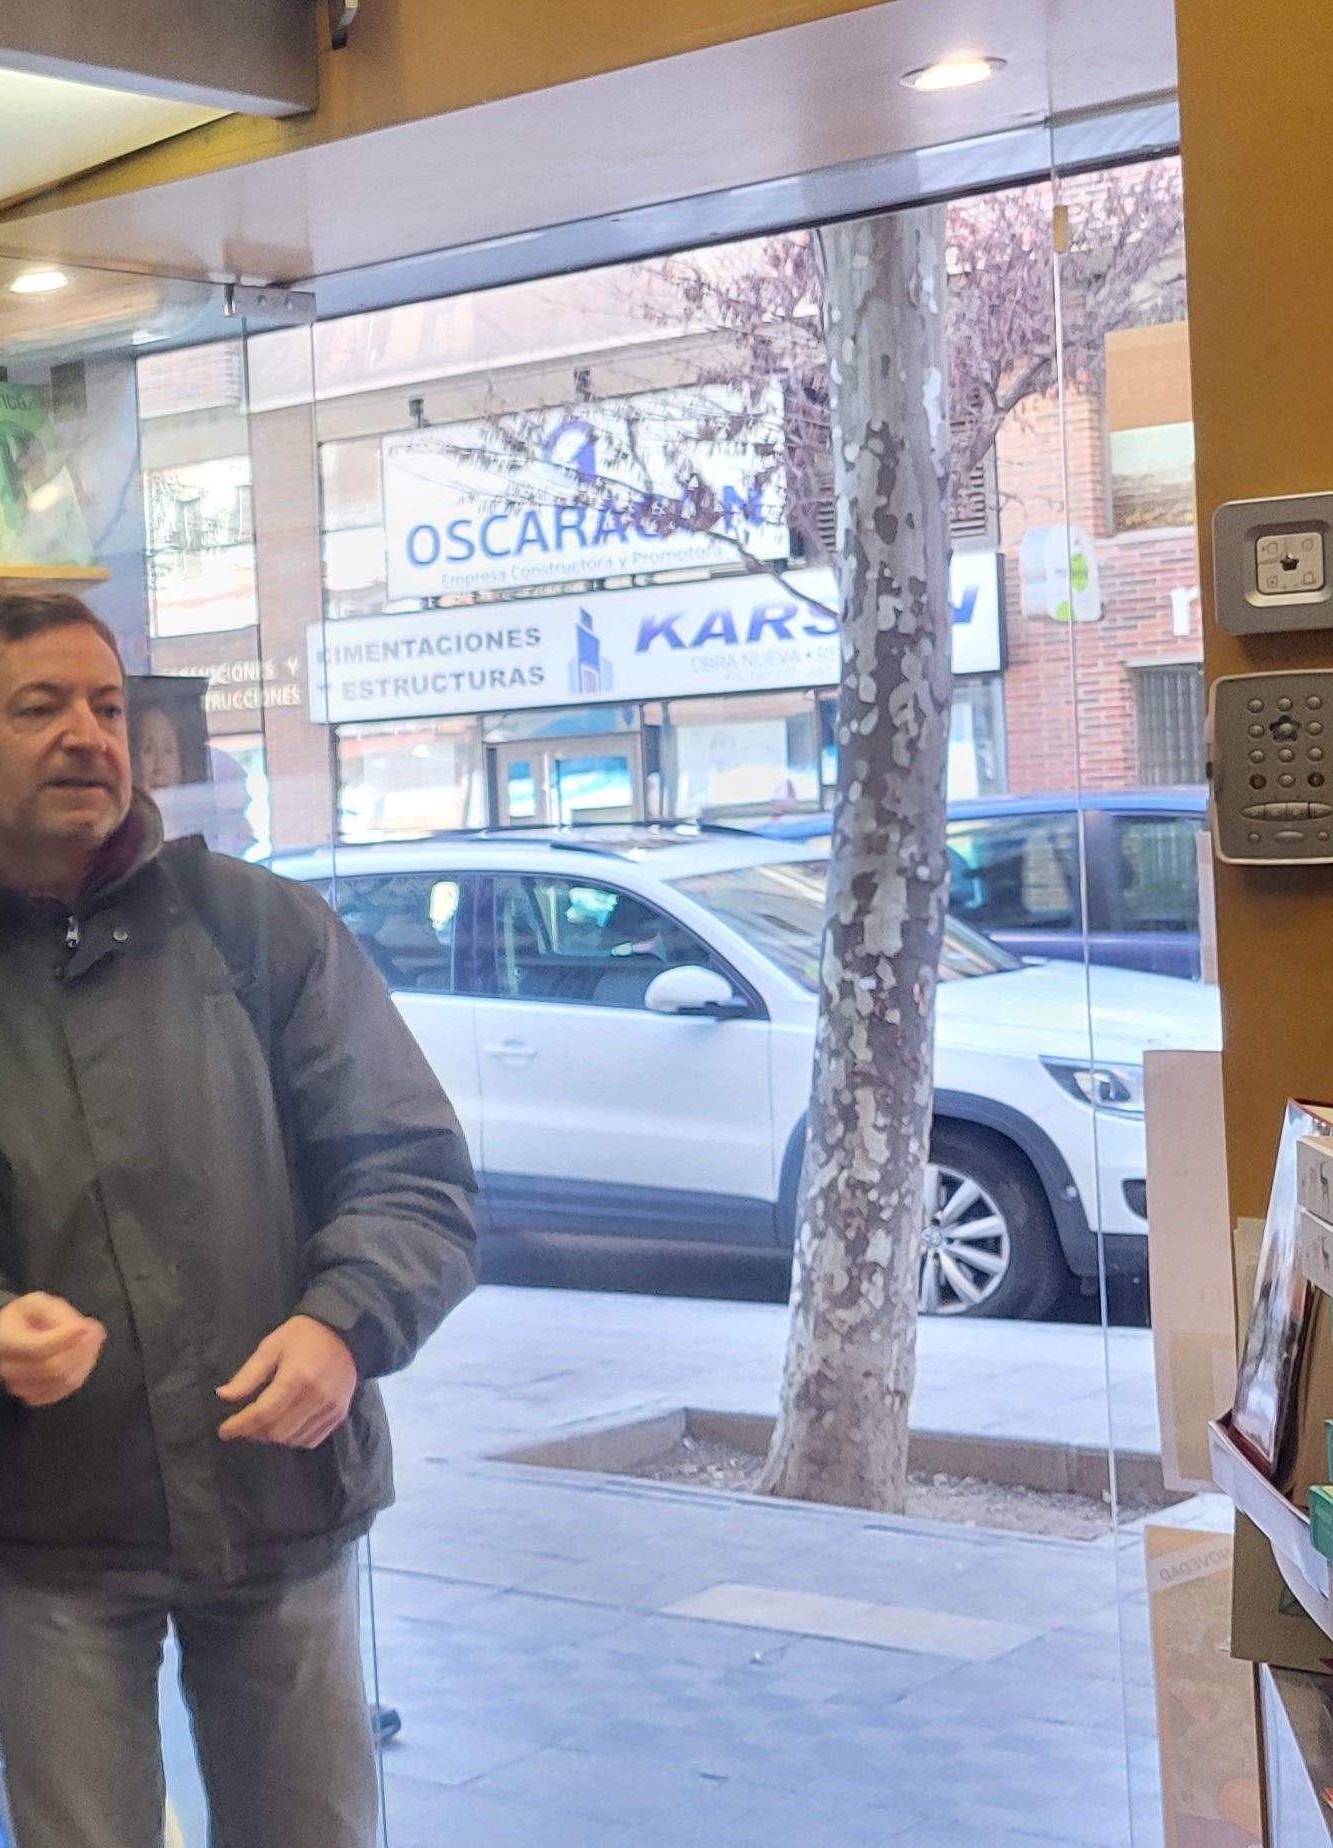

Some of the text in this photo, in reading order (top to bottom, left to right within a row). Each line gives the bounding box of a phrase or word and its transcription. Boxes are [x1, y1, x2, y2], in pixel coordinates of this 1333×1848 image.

[441, 570, 507, 587] Empresa
[511, 556, 613, 581] Constructora
[633, 545, 723, 567] Promotora
[342, 665, 546, 701] ESTRUCTURAS
